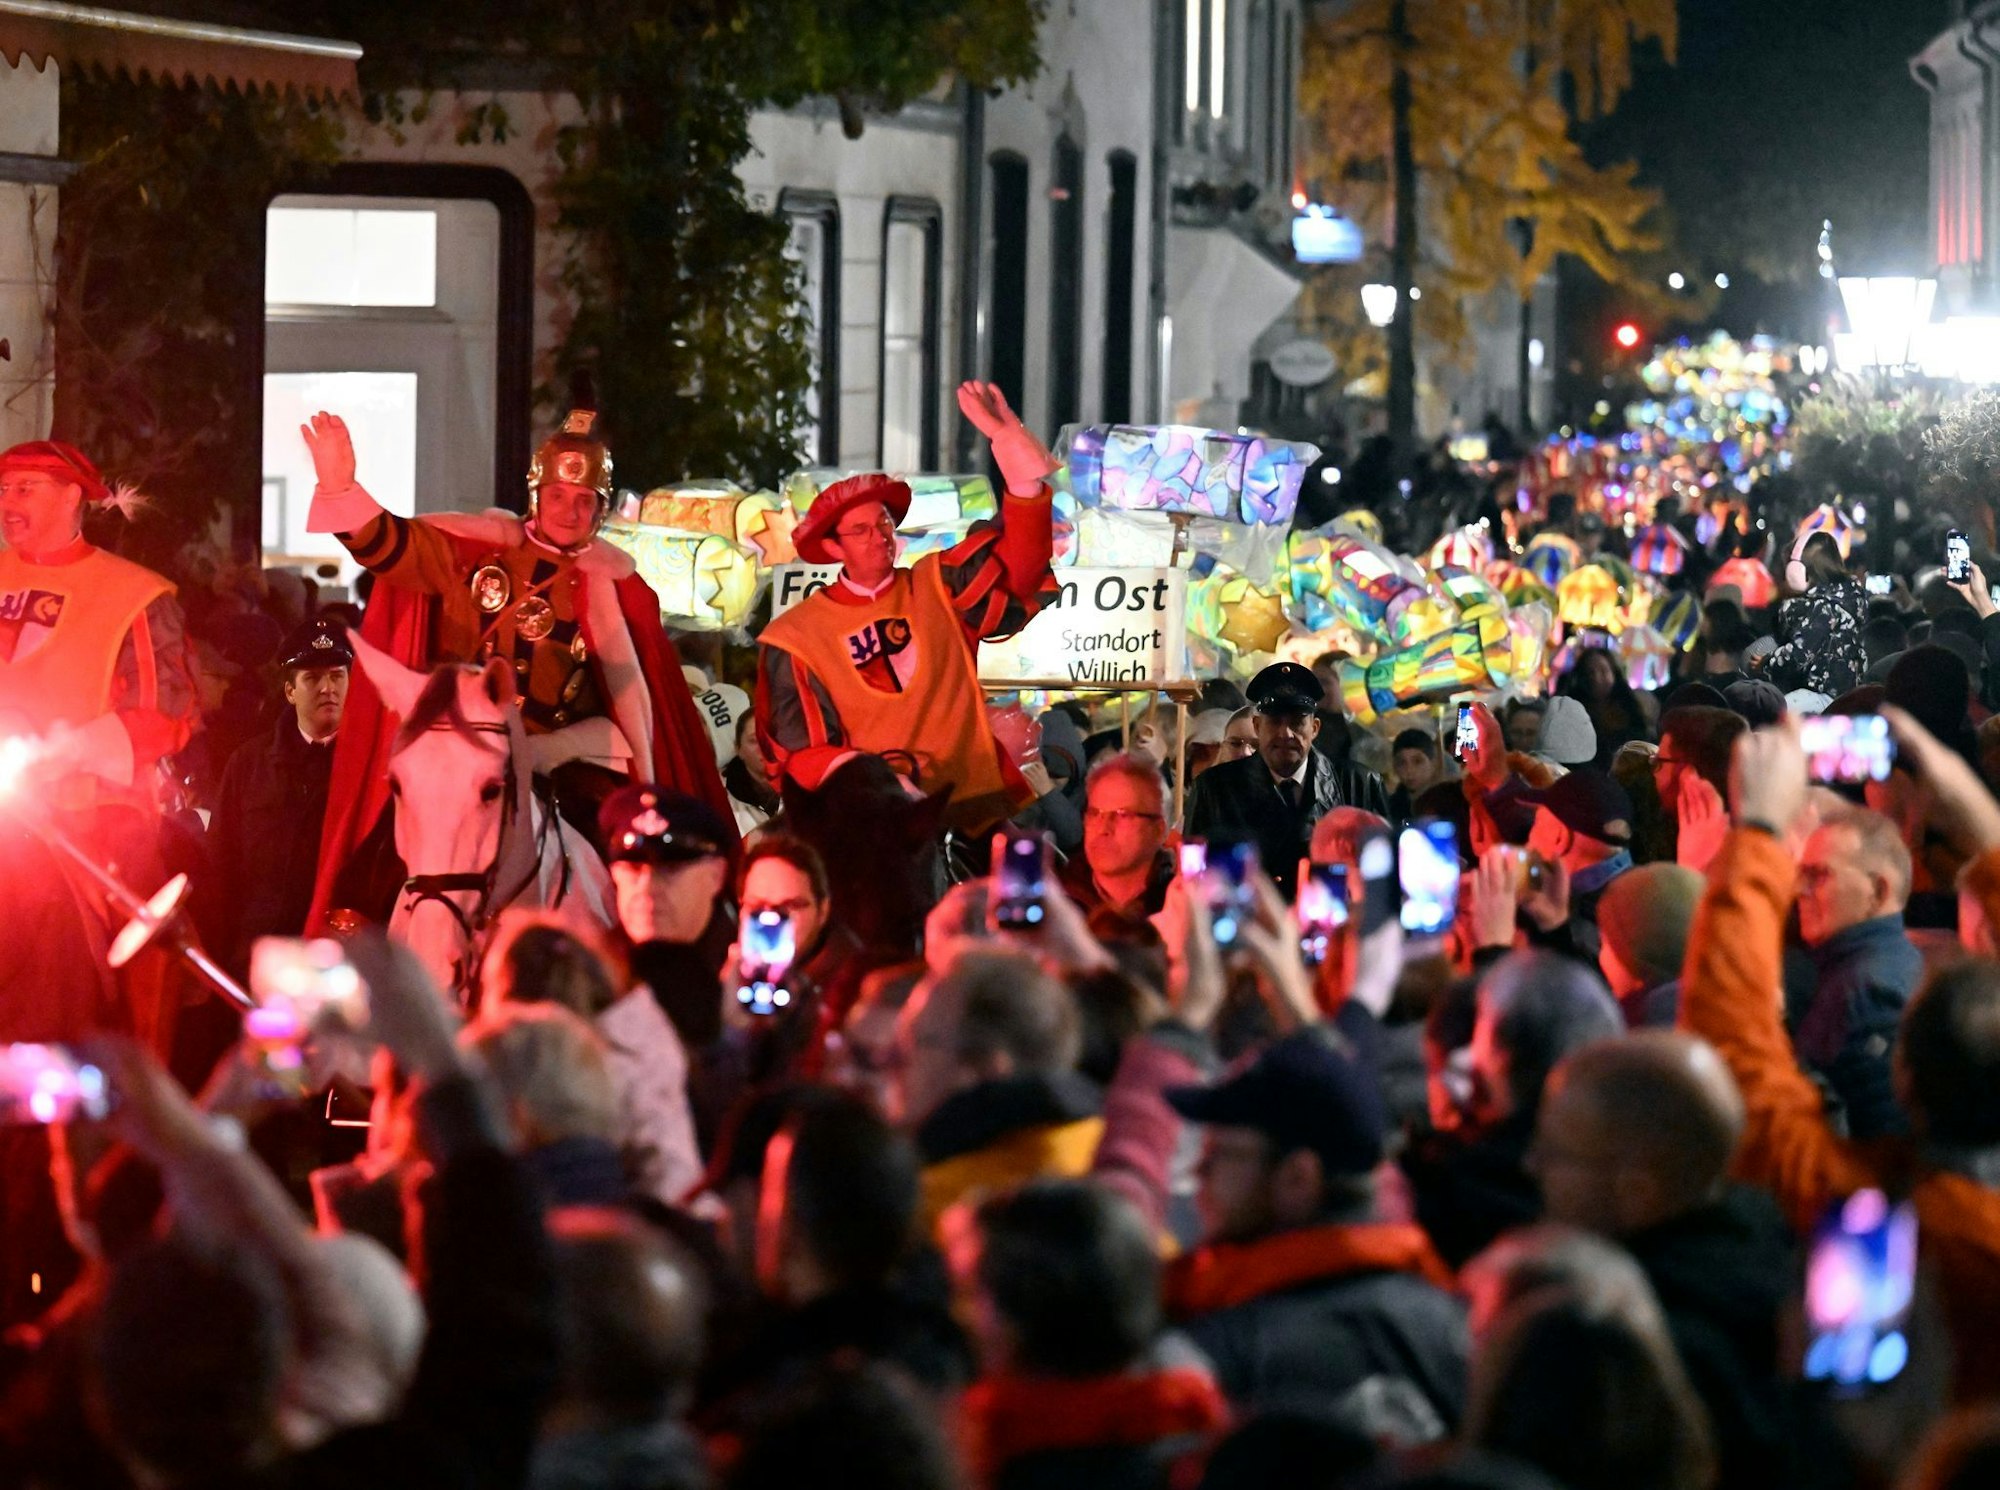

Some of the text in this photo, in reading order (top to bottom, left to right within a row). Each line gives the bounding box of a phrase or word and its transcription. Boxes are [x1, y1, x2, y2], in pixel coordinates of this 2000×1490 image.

[780, 571, 828, 605] Fö
[1094, 576, 1169, 611] Ost
[1061, 628, 1161, 653] Standort
[1068, 658, 1146, 682] Willich
